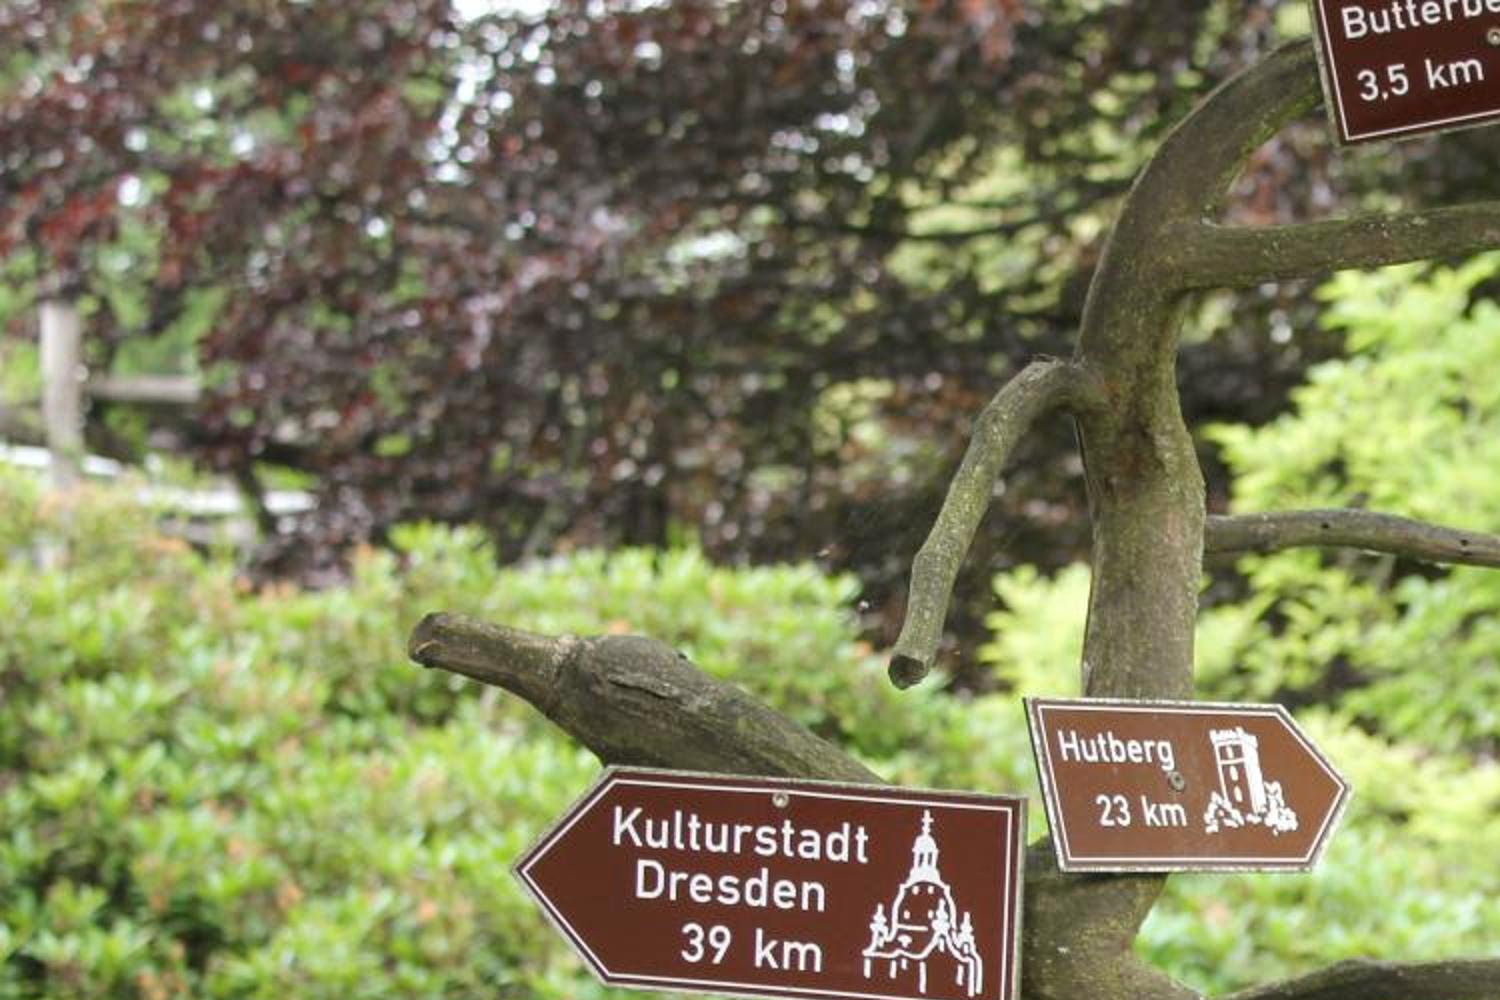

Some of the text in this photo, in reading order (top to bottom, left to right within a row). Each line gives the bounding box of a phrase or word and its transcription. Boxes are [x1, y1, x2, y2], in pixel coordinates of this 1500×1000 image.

[1424, 58, 1484, 91] km
[1057, 730, 1174, 770] Hutberg
[1096, 795, 1187, 826] 23 km
[613, 806, 868, 864] Kulturstadt
[636, 859, 825, 911] Dresden
[681, 923, 822, 972] 39 km
